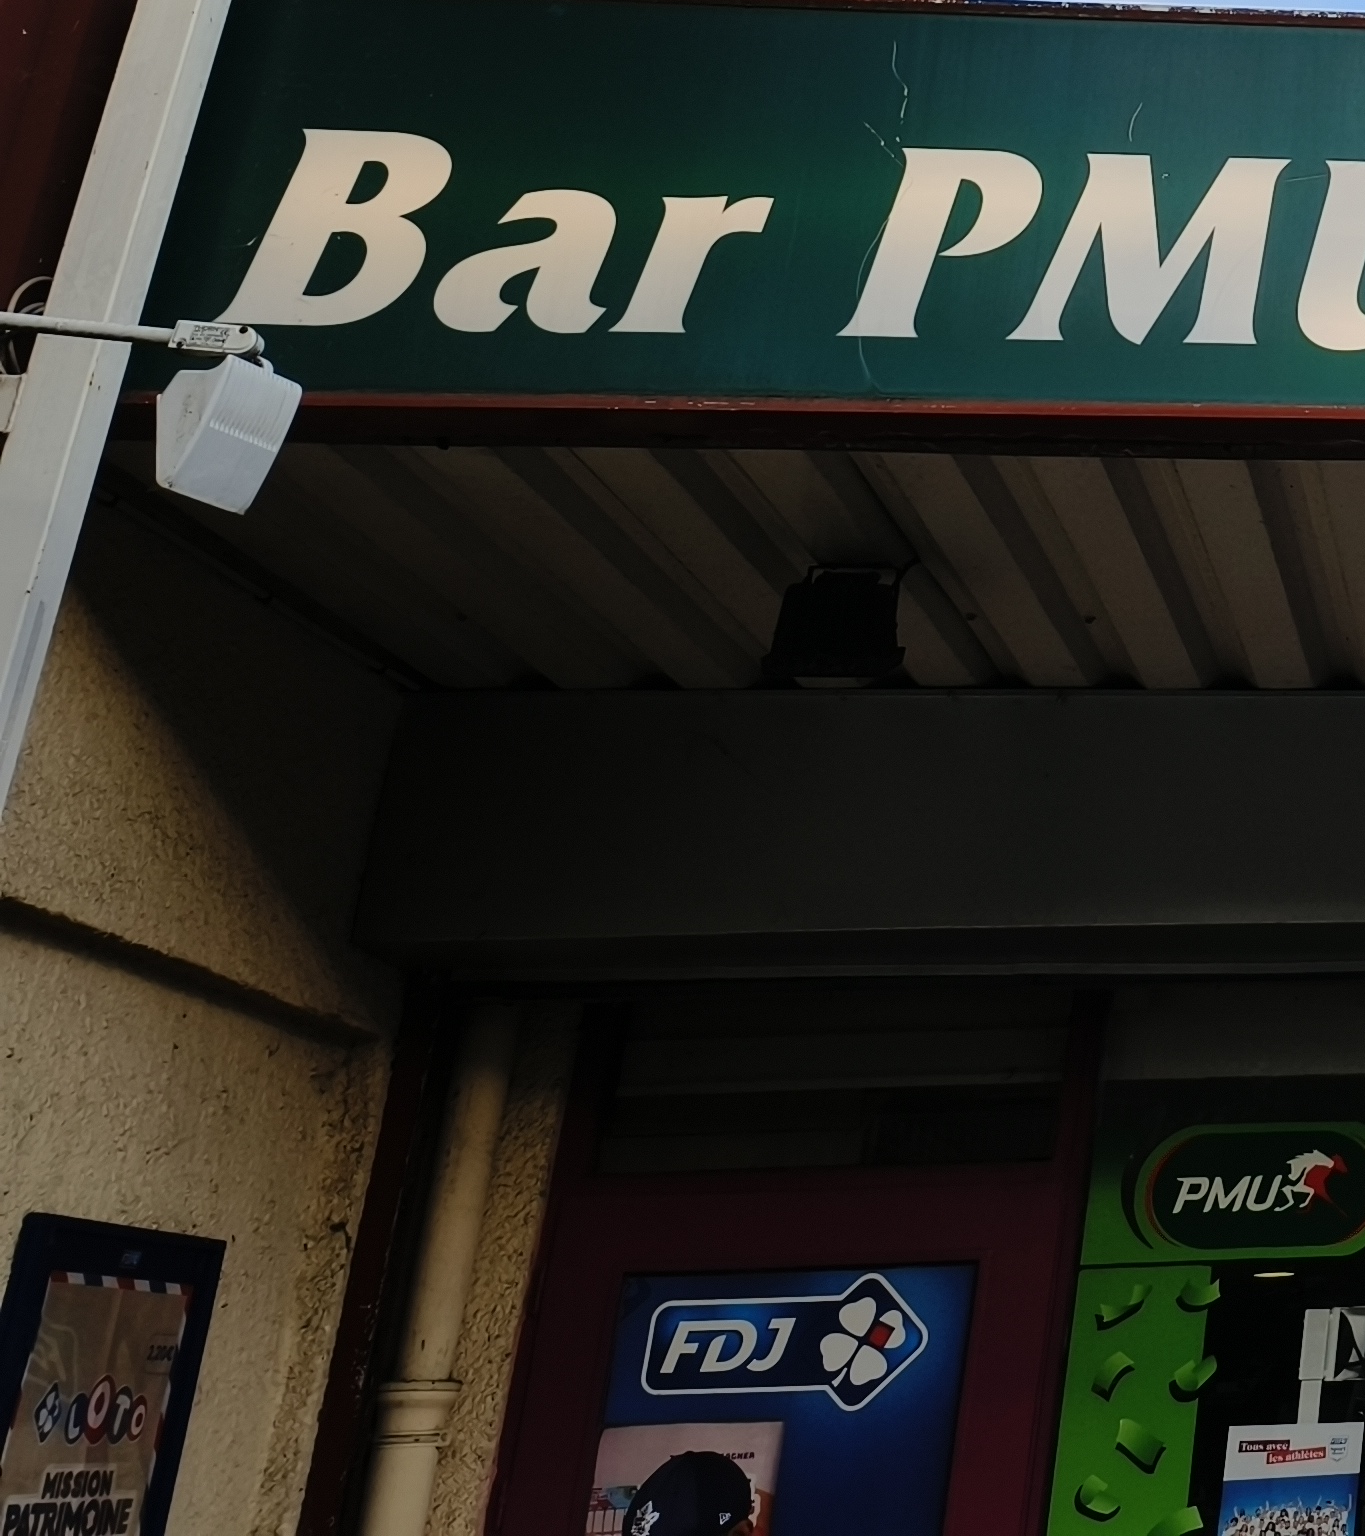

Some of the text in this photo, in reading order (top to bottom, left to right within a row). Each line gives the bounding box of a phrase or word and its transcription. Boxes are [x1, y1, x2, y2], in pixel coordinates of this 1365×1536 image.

[212, 128, 774, 334] Bar
[1172, 1175, 1283, 1214] PMU
[659, 1317, 797, 1374] FDJ
[66, 1375, 147, 1444] LOTO
[1241, 1442, 1289, 1452] Tous avec
[1269, 1453, 1284, 1463] les
[41, 1469, 115, 1500] MISSION
[2, 1498, 134, 1536] PATRIMOINE
